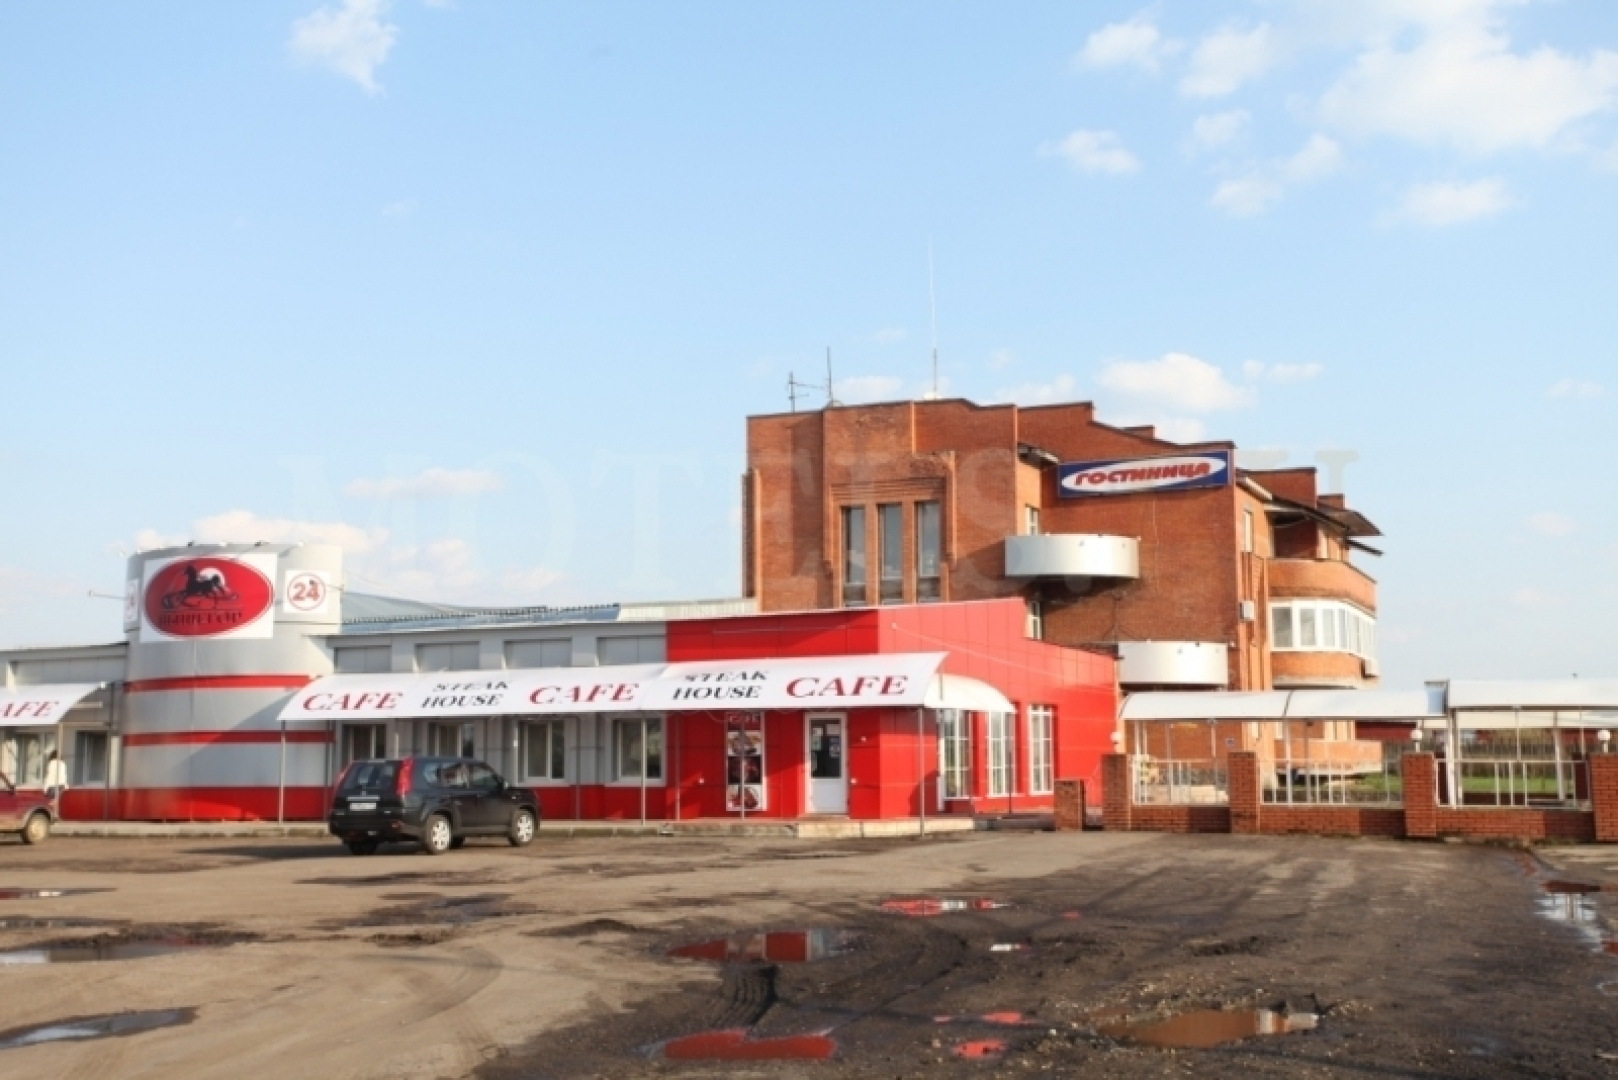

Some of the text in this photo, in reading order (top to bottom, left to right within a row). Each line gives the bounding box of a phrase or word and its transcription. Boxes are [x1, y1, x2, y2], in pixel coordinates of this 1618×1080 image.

[1075, 462, 1210, 486] ГОСТИНИЦА
[293, 580, 321, 602] 24
[686, 671, 768, 683] STEAK
[786, 675, 908, 697] CAFE
[303, 692, 402, 711] CAFE
[421, 694, 502, 709] HOUSE
[529, 683, 640, 705] CAFE
[674, 686, 760, 700] HOUSE
